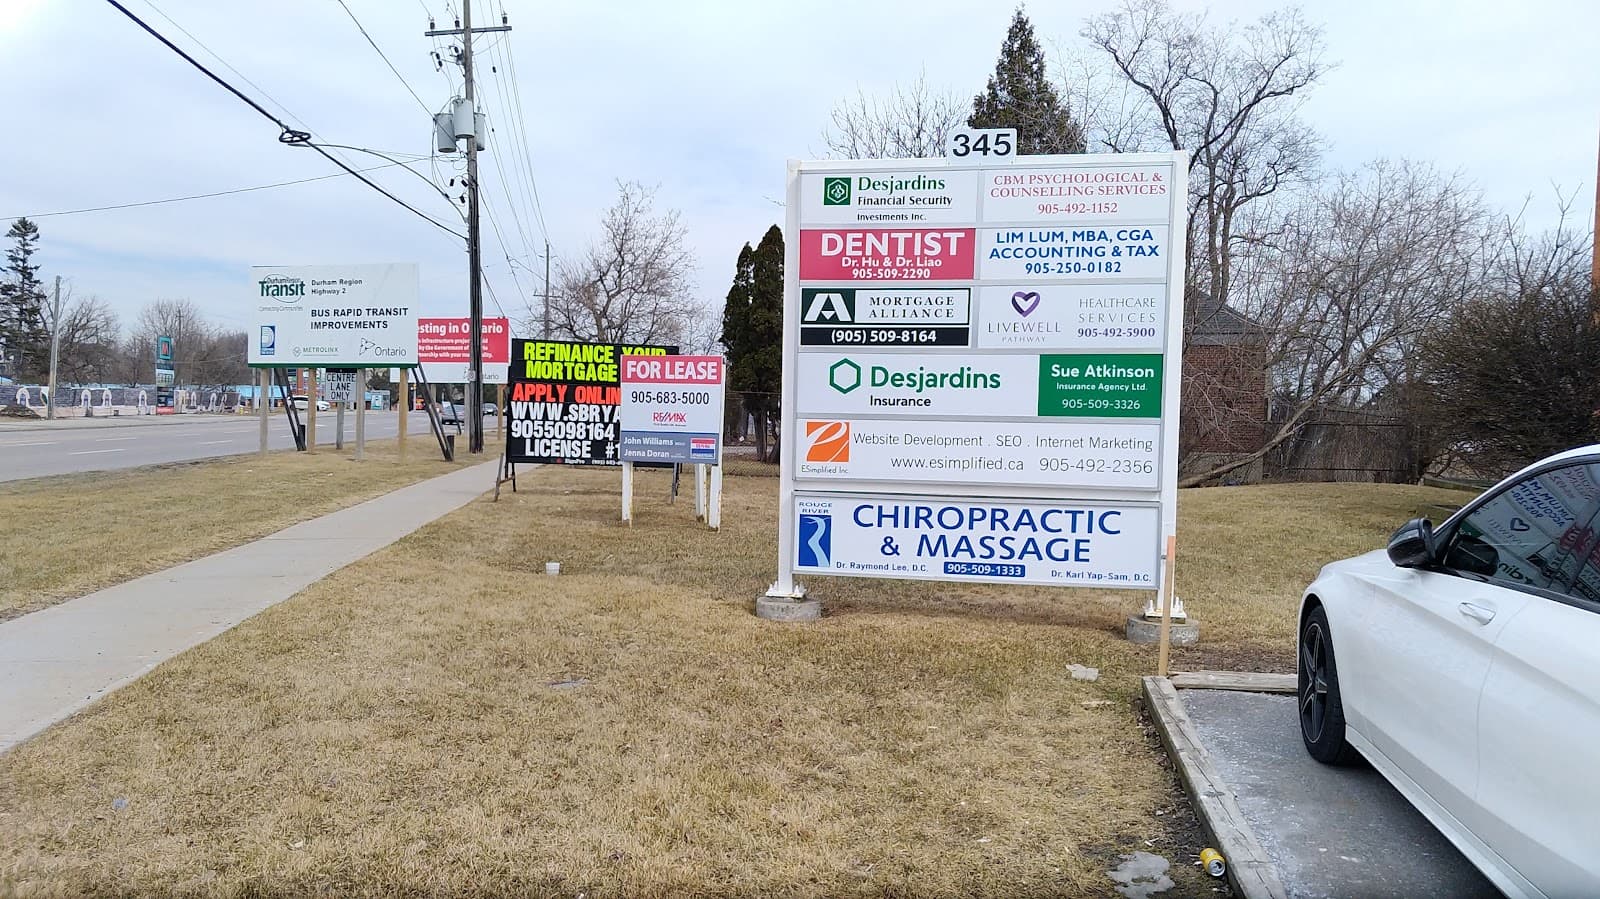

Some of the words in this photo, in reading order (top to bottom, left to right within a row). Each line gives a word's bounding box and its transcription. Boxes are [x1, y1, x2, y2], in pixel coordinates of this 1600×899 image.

[952, 133, 1012, 158] 345
[994, 175, 1024, 185] CBM
[1029, 172, 1148, 185] PSYCHOLOGICAL
[1152, 172, 1163, 182] &
[858, 175, 945, 195] Desjardins
[990, 185, 1094, 198] COUNSELLING
[1098, 185, 1166, 196] SERVICES
[857, 196, 905, 206] Financial
[909, 196, 952, 206] Security
[1038, 202, 1118, 214] 905-492-1152
[857, 213, 908, 221] Investments
[911, 213, 926, 221] Inc.
[996, 231, 1023, 243] LIM
[1029, 230, 1068, 244] LUM,
[1073, 230, 1112, 244] MBA,
[1116, 229, 1154, 241] CGA
[821, 232, 965, 256] DENTIST
[989, 246, 1106, 259] ACCOUNTING
[1111, 245, 1122, 257] &
[1126, 245, 1159, 257] TAX
[842, 257, 859, 268] Dr.
[862, 257, 879, 268] Hu
[883, 257, 893, 268] &
[896, 257, 913, 268] Dr.
[917, 256, 942, 268] Liao
[1025, 261, 1121, 274] 905-250-0182
[852, 268, 930, 279] 905-509-2290
[258, 280, 306, 297] Transit
[339, 278, 363, 287] Region
[311, 288, 340, 296] Highway
[869, 296, 955, 306] MORTGAGE
[1079, 297, 1156, 308] HEALTHCARE
[311, 309, 331, 317] BUS
[333, 308, 363, 317] RAPID
[365, 307, 409, 317] TRANSIT
[869, 308, 955, 318] ALLIANCE
[1078, 312, 1156, 323] SERVICES
[310, 320, 388, 330] IMPROVEMENTS
[448, 322, 460, 334] in
[988, 321, 1061, 333] LIVEWELL
[831, 329, 867, 344] (905)
[870, 329, 937, 343] 509-8164
[1077, 327, 1156, 338] 905-492-5900
[374, 345, 407, 357] Ontario
[524, 342, 614, 363] REFINANCE
[526, 361, 618, 382] MORTGAGE
[627, 360, 661, 379] FOR
[665, 361, 717, 380] LEASE
[1051, 363, 1080, 378] Sue
[1084, 364, 1155, 378] Atkinson
[326, 373, 356, 383] CENTRE
[871, 366, 1001, 393] Desjardins
[330, 383, 351, 392] LANE
[512, 383, 567, 403] APPLY
[1056, 382, 1096, 391] Insurance
[1098, 382, 1129, 393] Agency
[1131, 383, 1148, 391] Ltd.
[330, 391, 350, 401] ONLY
[631, 391, 710, 405] 905-683-5000
[870, 395, 932, 407] Insurance
[1062, 398, 1141, 410] 905-509-3326
[653, 411, 687, 423] RE/MAX
[511, 420, 615, 441] 9055098164
[623, 436, 642, 445] John
[642, 437, 674, 446] Williams
[853, 433, 900, 445] Website
[904, 433, 983, 448] Development
[996, 434, 1022, 447] SEO
[1036, 435, 1084, 449] Internet
[1089, 436, 1153, 452] Marketing
[525, 438, 591, 458] LICENSE
[623, 449, 646, 457] Jenna
[647, 449, 670, 458] Doran
[891, 456, 1024, 471] www.esimplified.ca
[1039, 458, 1153, 474] 905-492-2356
[853, 504, 1121, 535] CHIROPRACTIC
[880, 536, 900, 556] &
[917, 534, 1091, 563] MASSAGE
[836, 561, 848, 569] Dr.
[850, 562, 889, 571] Raymond
[947, 563, 1022, 576] 905-509-1333
[1051, 569, 1063, 578] Dr.
[1066, 571, 1085, 579] Karl
[1087, 572, 1131, 582] Yap-Sam,
[1134, 573, 1151, 582] D.C.
